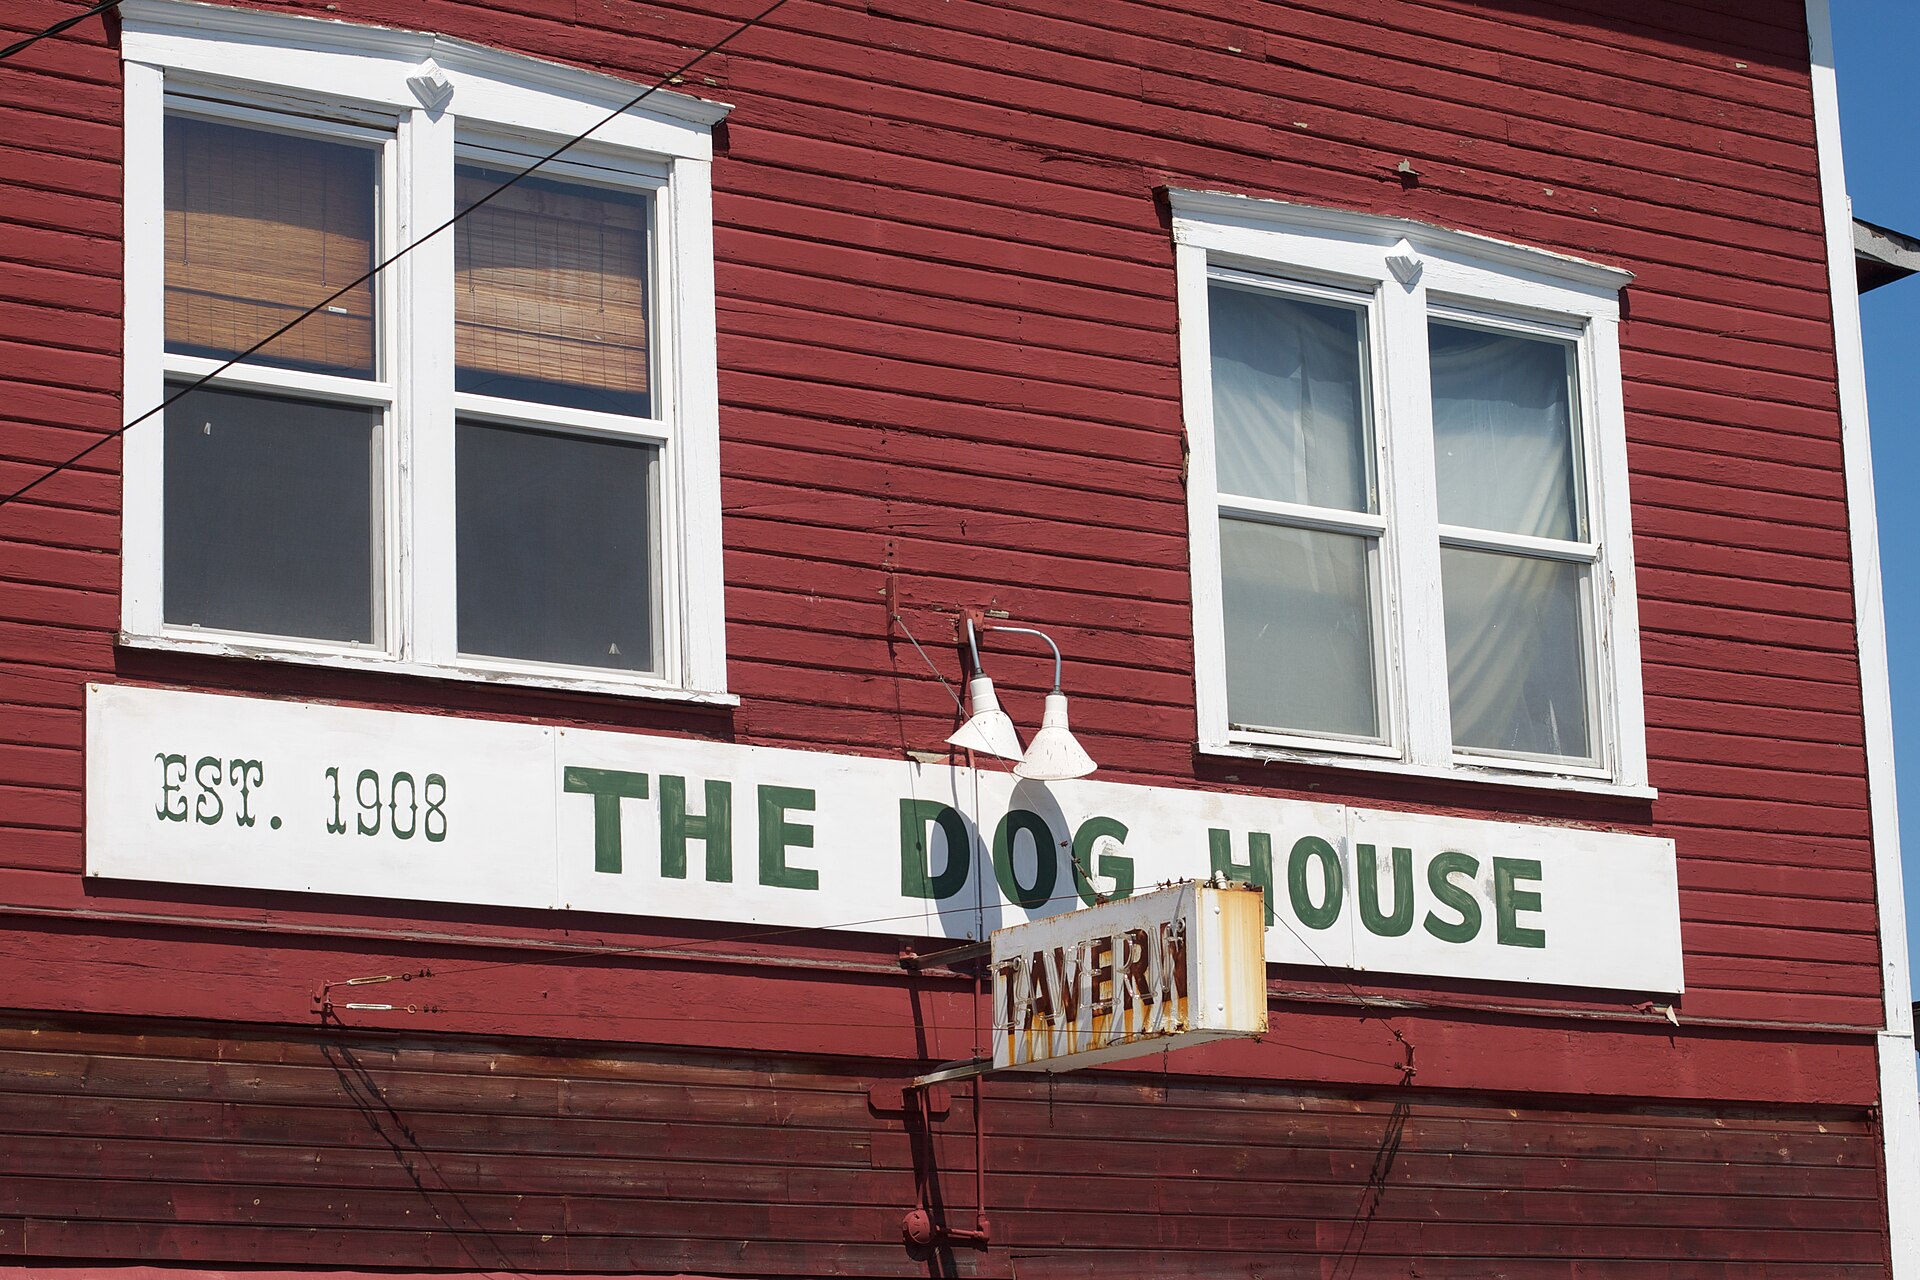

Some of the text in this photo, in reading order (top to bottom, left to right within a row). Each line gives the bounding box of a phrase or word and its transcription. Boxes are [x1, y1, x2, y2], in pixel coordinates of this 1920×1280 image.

[154, 752, 448, 842] EST. 1908
[563, 766, 1546, 948] THE DOG HOUSE
[989, 917, 1189, 1036] TAVERN
